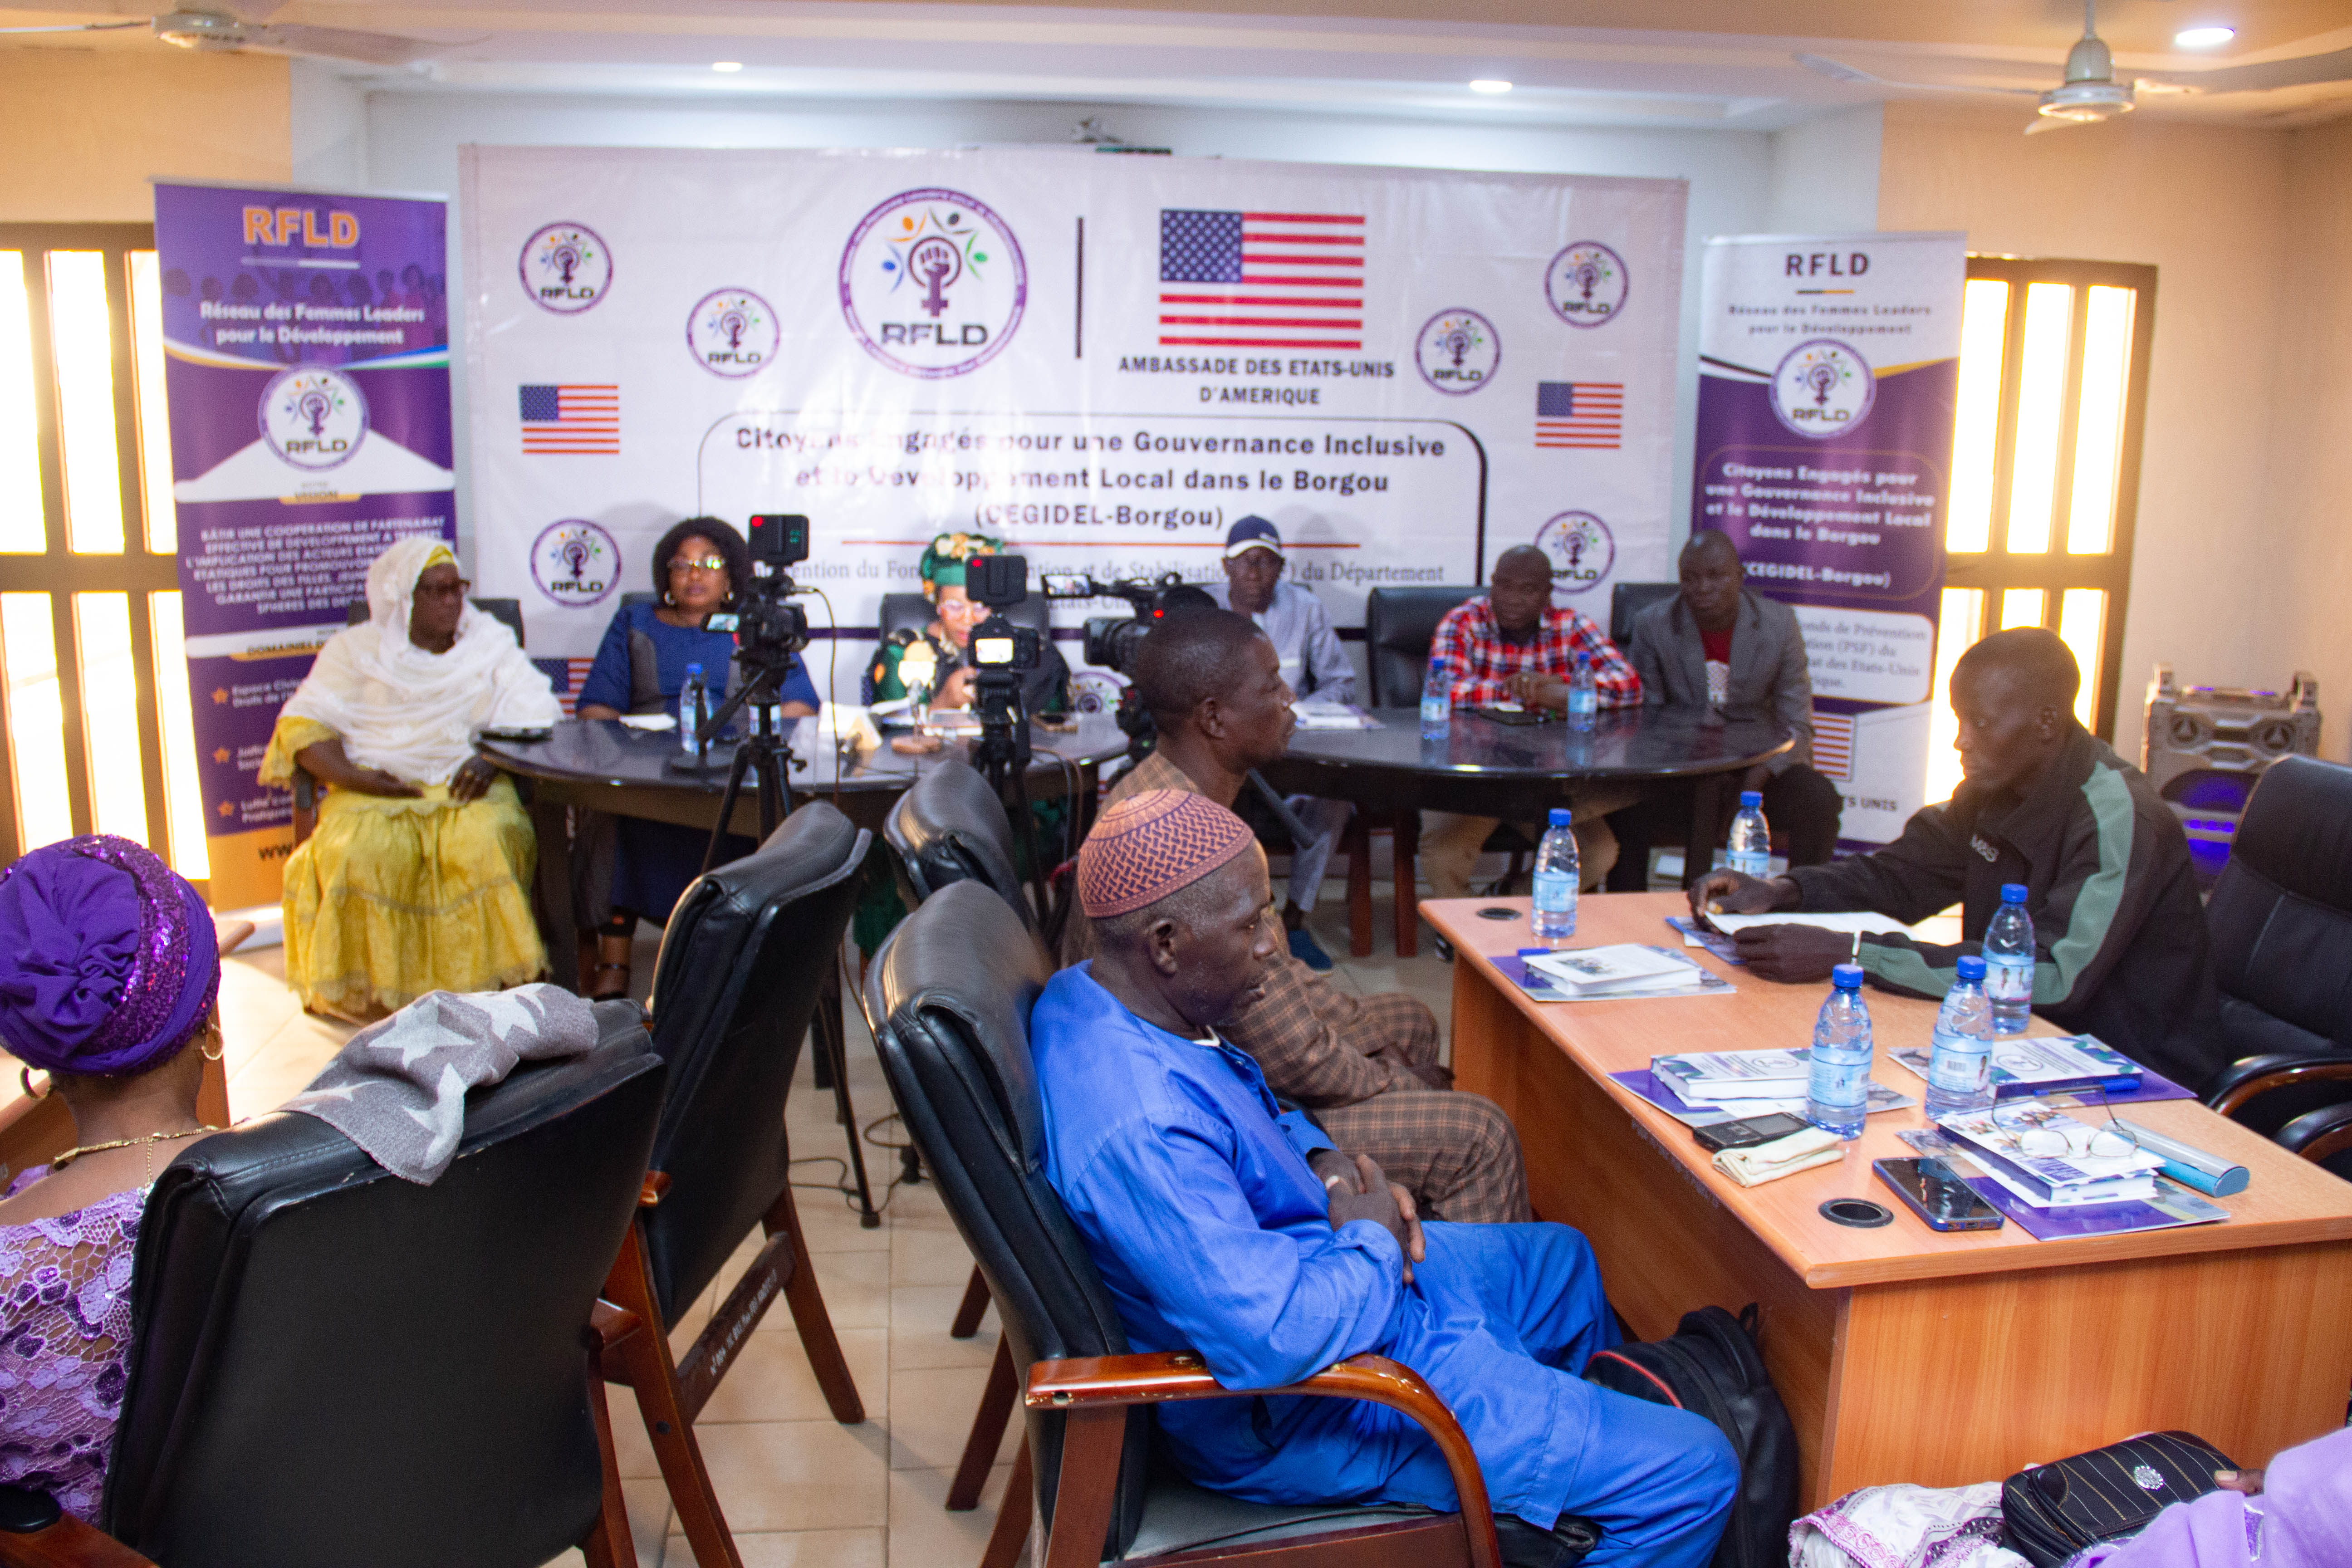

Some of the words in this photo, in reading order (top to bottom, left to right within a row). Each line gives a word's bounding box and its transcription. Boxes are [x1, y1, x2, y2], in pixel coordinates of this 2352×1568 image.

[243, 207, 359, 248] RFLD
[1785, 251, 1870, 276] RFLD
[540, 287, 594, 299] RFLD
[264, 301, 292, 320] des
[294, 302, 362, 321] Femmes
[363, 304, 426, 322] Leaders
[1563, 301, 1611, 314] RFLD
[216, 328, 257, 345] pour
[259, 325, 275, 343] le
[881, 323, 988, 346] RFLD
[708, 352, 761, 364] RFLD
[1118, 357, 1238, 375] AMBASSADE
[1246, 358, 1281, 376] DES
[1290, 359, 1395, 378] ETATS-UNIS
[1434, 369, 1482, 382] RFLD
[1200, 386, 1320, 406] D'AMERIQUE
[1792, 408, 1850, 421] RFLD
[287, 439, 348, 454] RFLD
[1073, 434, 1122, 451] une
[1134, 431, 1314, 454] Gouvernance
[1324, 432, 1446, 456] Inclusive
[1101, 469, 1173, 489] Local
[1184, 469, 1249, 490] dans
[1260, 470, 1283, 490] le
[1294, 470, 1389, 495] Borgou
[1722, 462, 1793, 481] Citoyens
[1875, 472, 1918, 486] pour
[1705, 484, 1737, 497] une
[1740, 482, 1852, 502] Gouvernance
[1855, 489, 1936, 507] Inclusive
[975, 504, 1224, 530] (CEGIDEL-Borgou)
[1705, 503, 1723, 515] et
[1727, 501, 1743, 516] le
[1885, 510, 1931, 527] Local
[1749, 523, 1791, 540] dans
[1795, 524, 1812, 540] le
[1816, 526, 1881, 546] Borgou
[857, 560, 879, 578] du
[1302, 561, 1324, 581] du
[1330, 561, 1444, 586] Département
[552, 581, 603, 592] RFLD
[1861, 797, 1897, 811] UNIS
